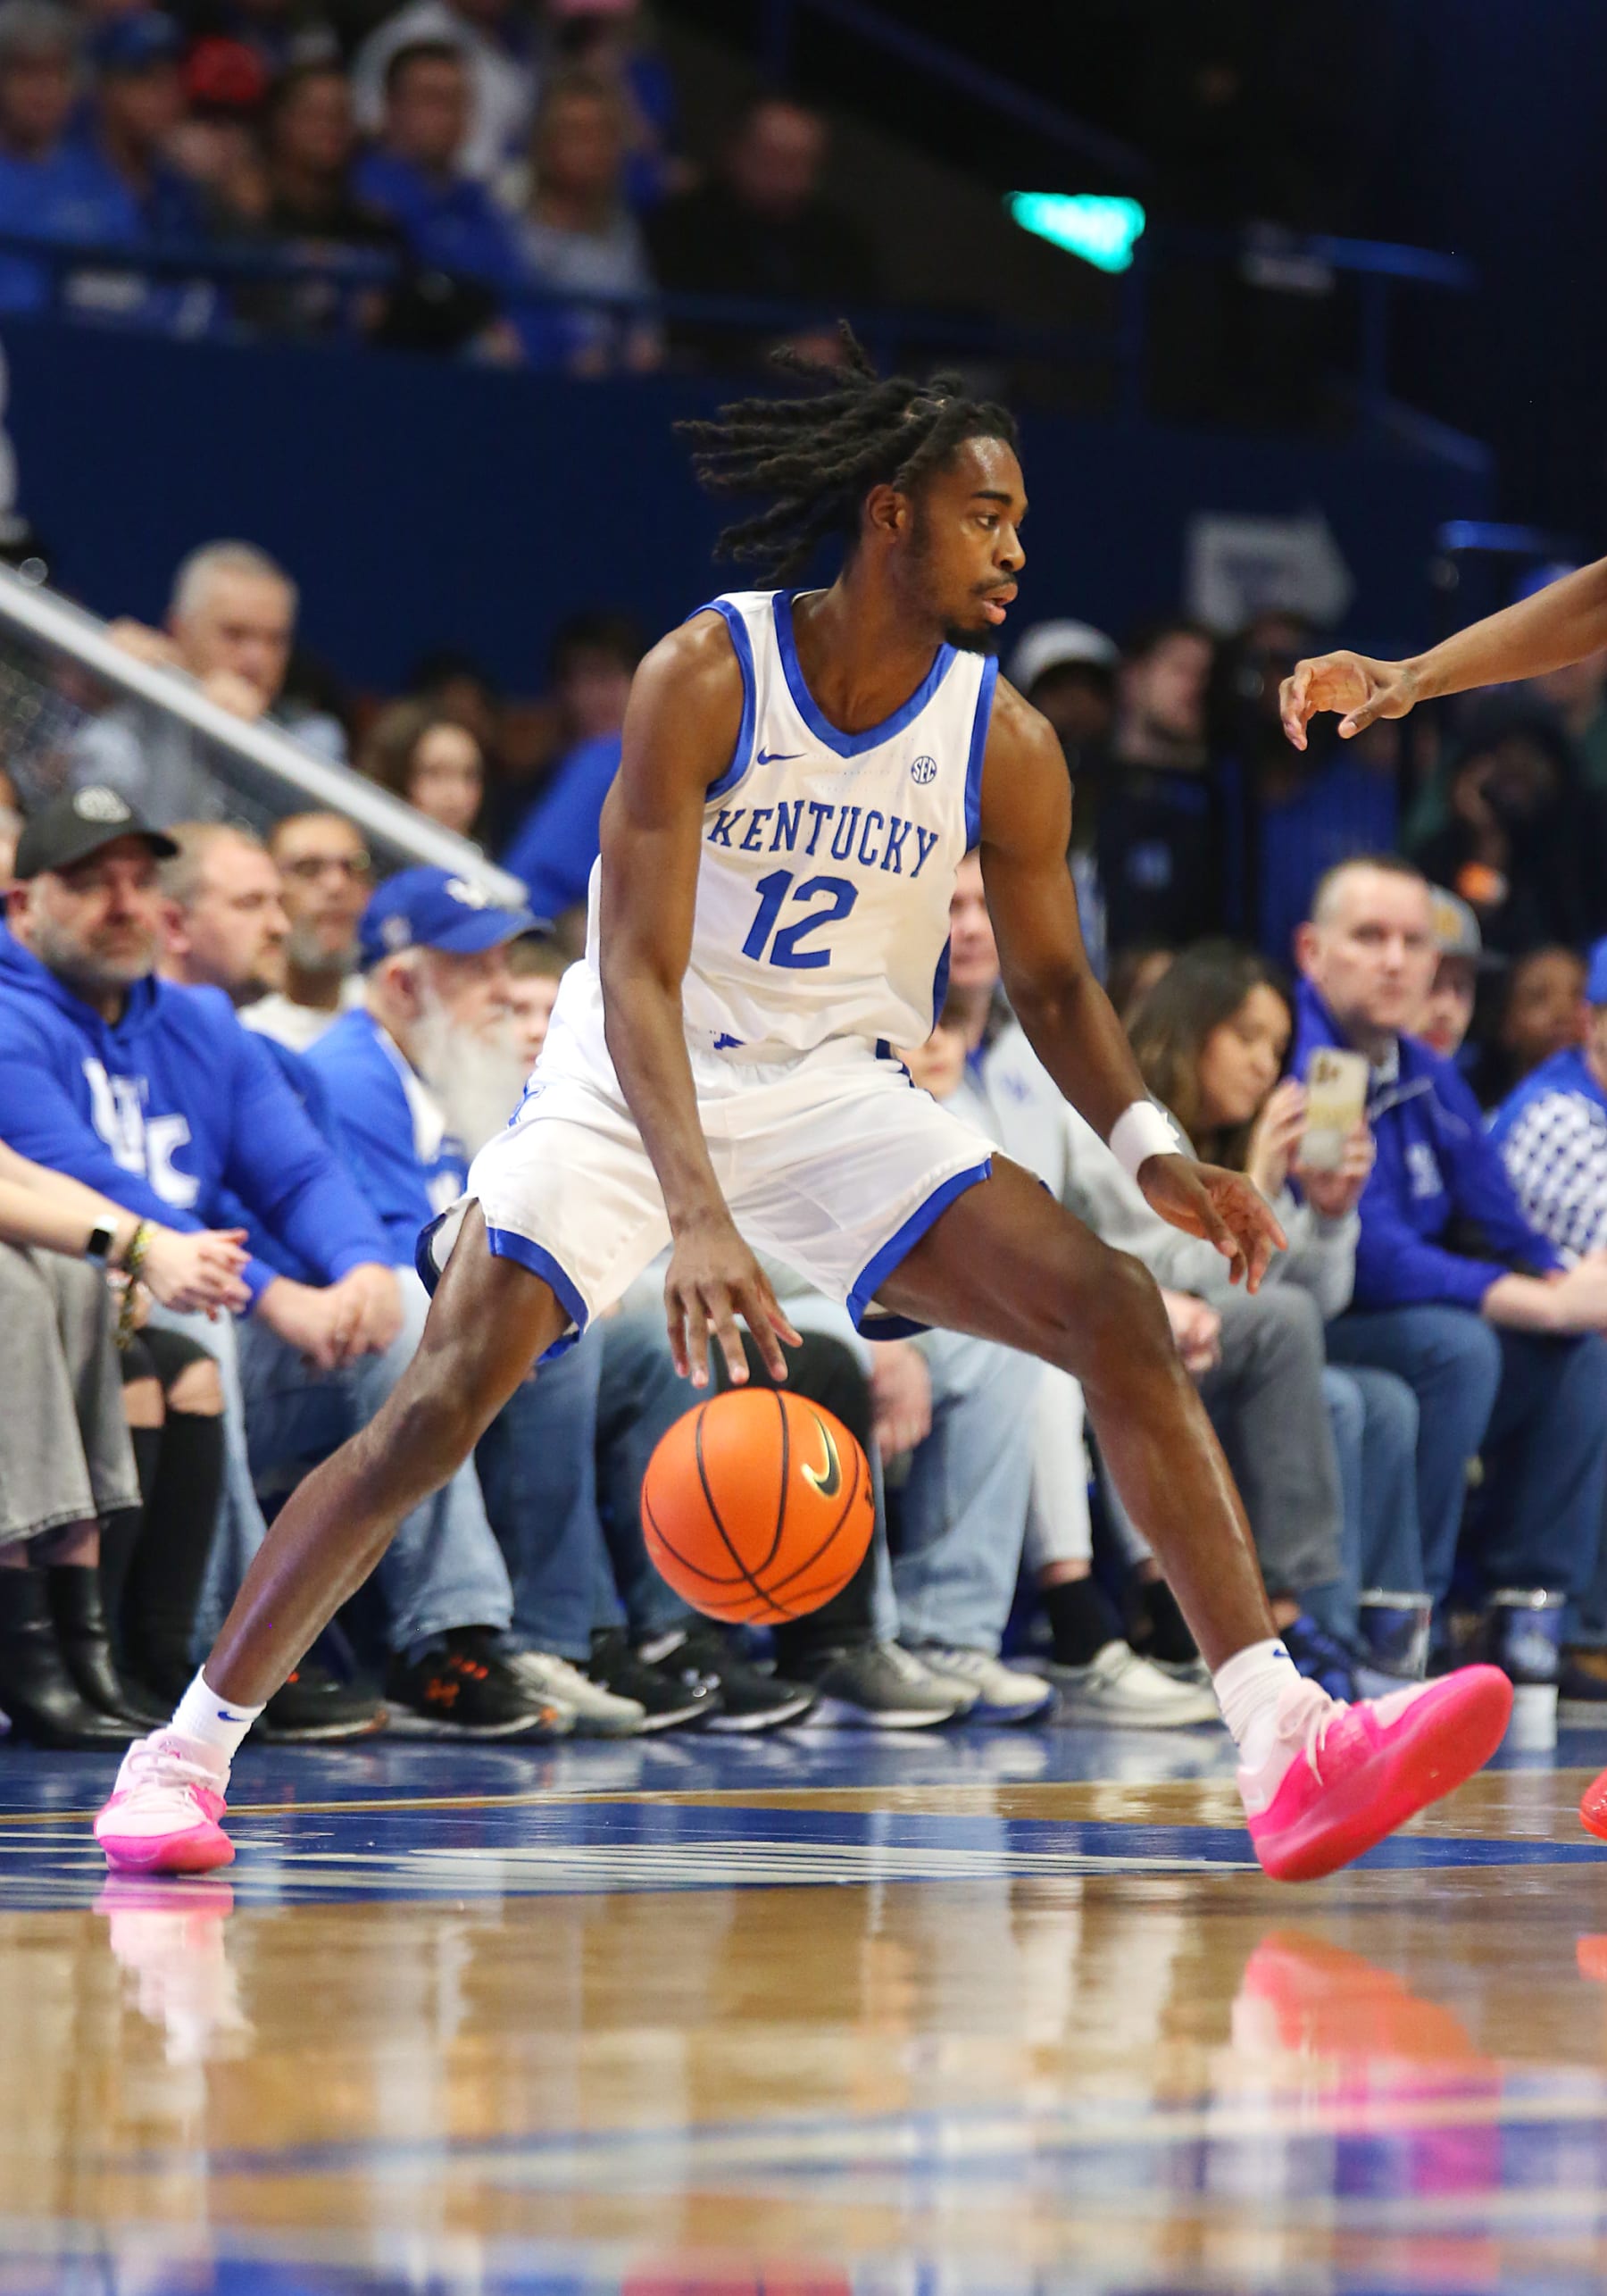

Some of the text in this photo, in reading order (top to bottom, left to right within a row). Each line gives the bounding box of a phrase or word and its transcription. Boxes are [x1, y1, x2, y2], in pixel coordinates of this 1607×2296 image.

[912, 756, 937, 784] SEC
[707, 799, 939, 878] KENTUCKY
[742, 869, 859, 969] 12
